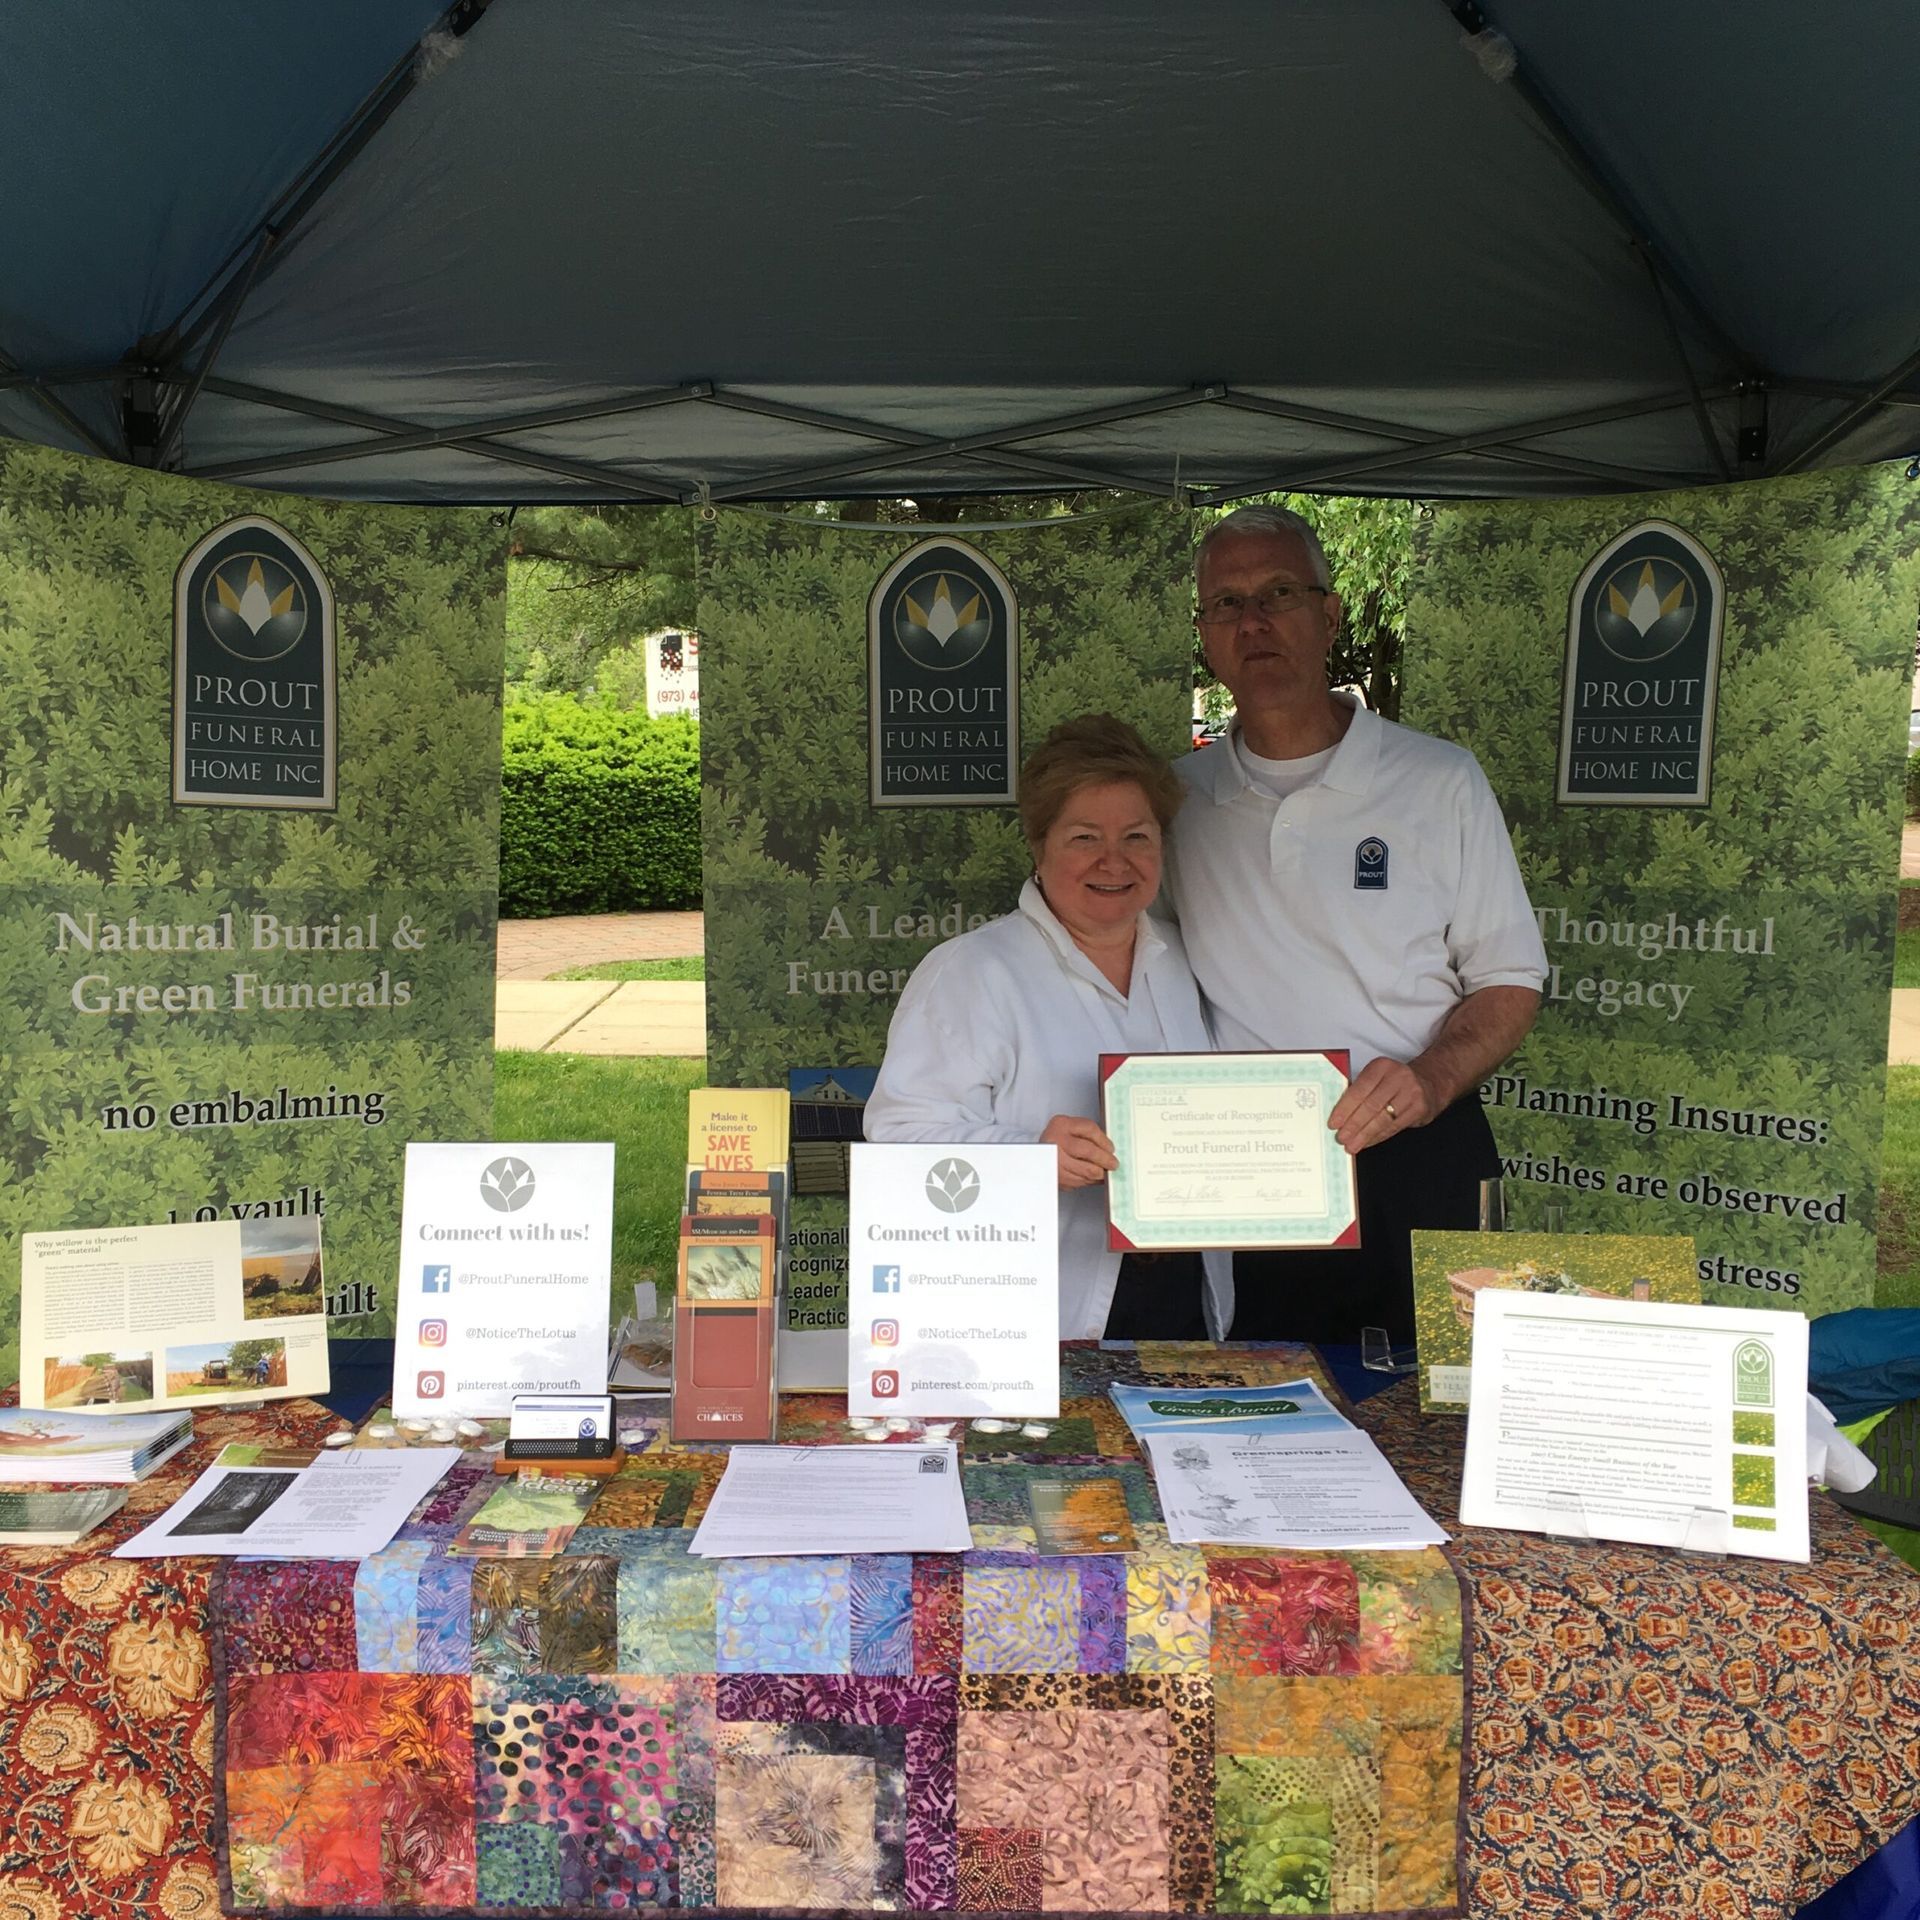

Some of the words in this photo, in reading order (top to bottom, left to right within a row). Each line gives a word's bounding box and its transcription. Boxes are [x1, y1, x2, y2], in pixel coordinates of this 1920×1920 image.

[194, 674, 319, 711] PROUT
[657, 688, 685, 703] (973)
[888, 686, 1003, 714] PROUT
[1583, 678, 1700, 709] PROUT
[190, 721, 321, 749] FUNERAL
[886, 729, 1006, 750] FUNERAL
[1576, 724, 1698, 745] FUNERAL
[190, 758, 263, 782] HOME
[275, 763, 321, 784] INC.
[886, 764, 950, 783] HOME
[963, 763, 1006, 782] INC.
[1573, 761, 1640, 780] HOME
[1650, 761, 1695, 781] INC.
[55, 912, 235, 952] Natural
[251, 913, 379, 951] Burial
[391, 914, 426, 950] &
[819, 906, 853, 940] A
[1533, 907, 1776, 960] Thoughtful
[785, 961, 914, 995] Funer
[71, 974, 216, 1015] Green
[232, 971, 412, 1010] Funerals
[1549, 965, 1695, 1022] Legacy
[103, 1103, 157, 1131] no
[169, 1085, 386, 1126] embalming
[711, 1112, 738, 1121] Make
[741, 1112, 748, 1121] it
[1160, 1111, 1215, 1122] Certificate
[1217, 1110, 1229, 1121] of
[1231, 1110, 1294, 1123] Recognition
[710, 1123, 744, 1132] license
[746, 1124, 758, 1132] to
[1668, 1095, 1830, 1145] Insures:
[708, 1135, 751, 1152] SAVE
[1162, 1142, 1199, 1154] Prout
[1202, 1141, 1251, 1154] Funeral
[1254, 1141, 1295, 1153] Home
[705, 1155, 754, 1172] LIVES
[1499, 1152, 1606, 1191] wishes
[1616, 1172, 1669, 1200] are
[1678, 1176, 1848, 1225] observed
[230, 1187, 326, 1222] vault
[418, 1223, 504, 1242] Connect
[509, 1222, 556, 1242] with
[561, 1223, 590, 1242] us!
[867, 1223, 952, 1243] Connect
[956, 1223, 1003, 1243] with
[1007, 1224, 1037, 1243] us!
[35, 1240, 53, 1250] Why
[56, 1239, 84, 1248] willow
[86, 1237, 93, 1246] is
[95, 1236, 108, 1245] the
[110, 1235, 138, 1245] perfect
[68, 1246, 102, 1255] material
[458, 1273, 589, 1287] @ProutFuneralHome
[907, 1274, 1038, 1287] @ProutFuneralHome
[1697, 1255, 1801, 1295] stress
[788, 1307, 849, 1326] Practic
[466, 1327, 577, 1340] @NoticeTheLotus
[917, 1327, 1028, 1341] @NoticeTheLotus
[456, 1378, 582, 1393] pinterest.com/proutfh
[910, 1379, 1036, 1393] pinterest.com/proutfh
[696, 1412, 744, 1422] CHICES
